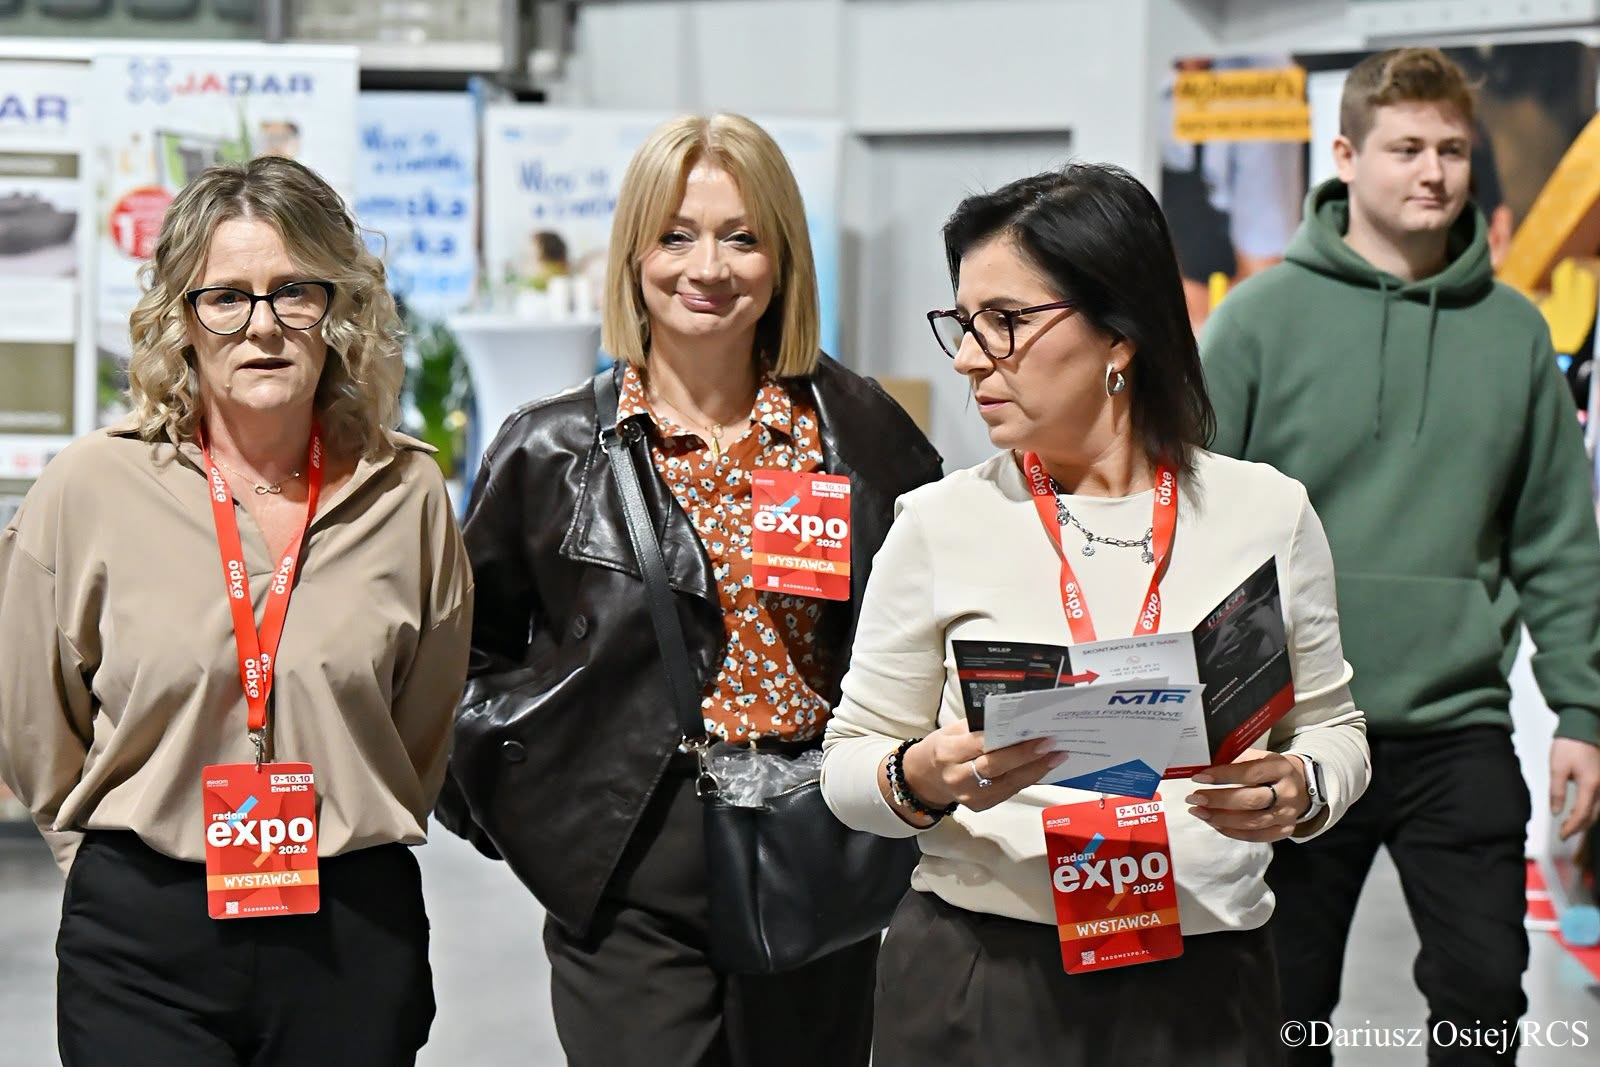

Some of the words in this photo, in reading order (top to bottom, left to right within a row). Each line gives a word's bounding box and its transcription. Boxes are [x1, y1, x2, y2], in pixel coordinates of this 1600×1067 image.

[174, 73, 316, 96] JADAR
[312, 436, 320, 468] expo
[211, 467, 227, 502] expo
[1030, 465, 1048, 496] expo
[1159, 471, 1173, 506] expo
[760, 504, 791, 513] radom
[754, 511, 848, 542] expo
[816, 539, 842, 548] 2026
[275, 556, 293, 595] expo
[767, 555, 835, 572] WYSTAWCA
[228, 560, 244, 599] expo
[1065, 582, 1084, 619] expo
[1142, 593, 1159, 630] expo
[245, 658, 260, 698] expo
[1108, 689, 1192, 705] MTR
[212, 811, 248, 821] radom
[1118, 818, 1140, 827] Enea
[1140, 815, 1158, 824] RCS
[1119, 803, 1160, 816] 9-10.10
[207, 816, 314, 853] expo
[278, 845, 308, 855] 2026
[1057, 852, 1095, 864] radom
[224, 873, 302, 888] WYSTAWCA
[1053, 852, 1169, 894] expo
[1133, 882, 1164, 895] 2026
[1076, 913, 1161, 937] WYSTAWCA
